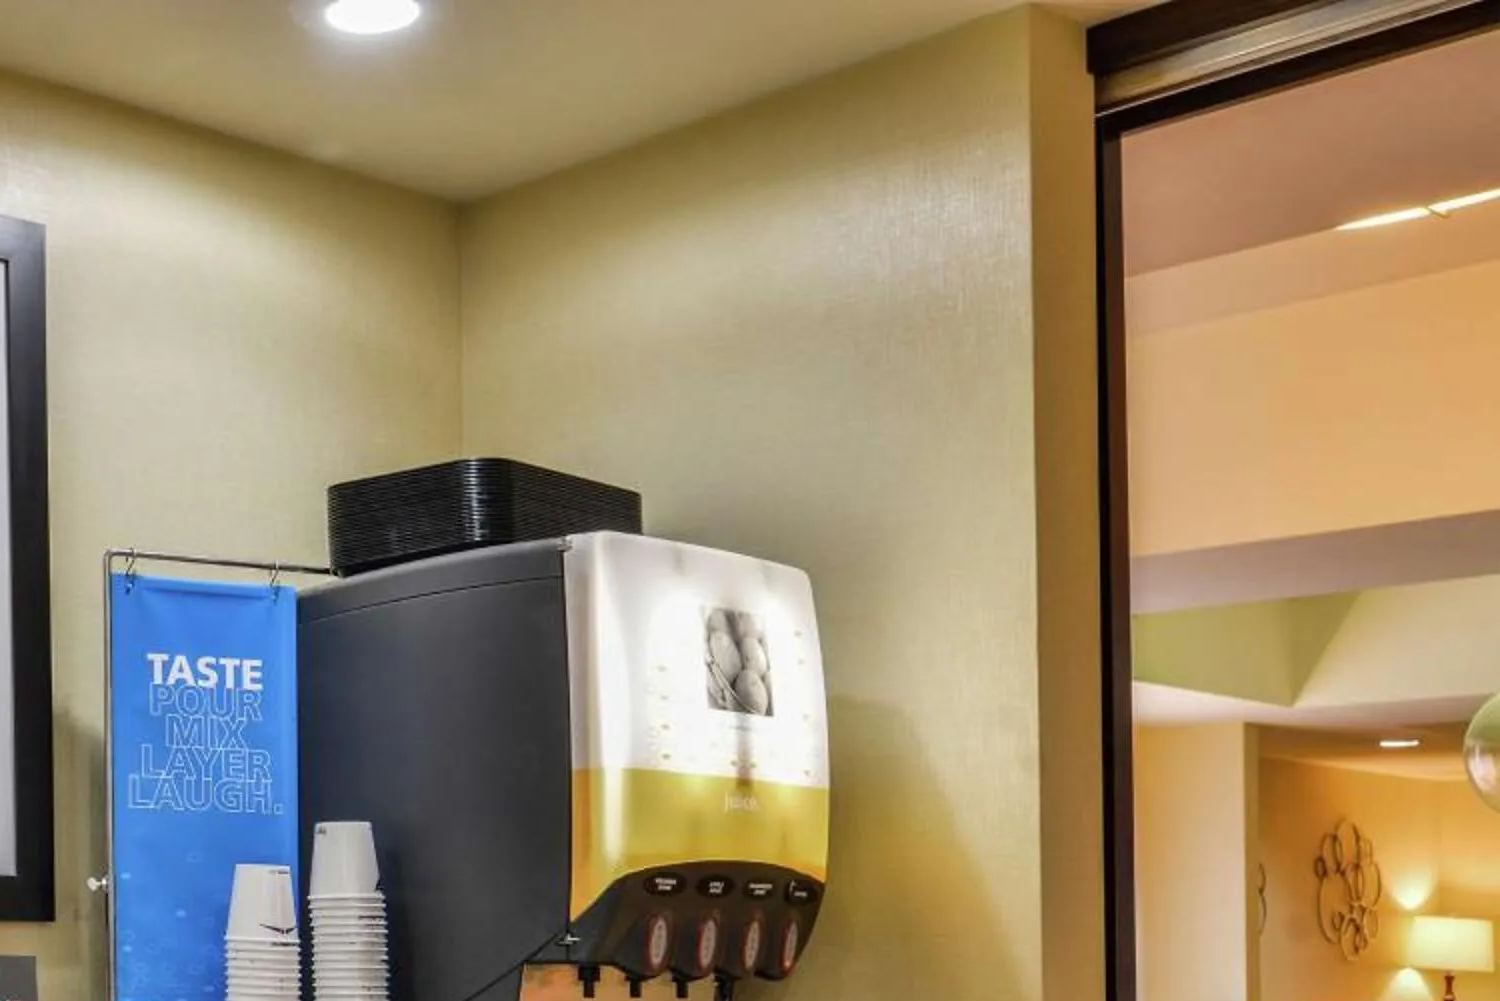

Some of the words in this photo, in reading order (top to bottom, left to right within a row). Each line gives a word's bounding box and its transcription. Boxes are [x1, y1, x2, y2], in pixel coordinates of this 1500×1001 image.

[147, 653, 263, 691] TASTE
[150, 682, 263, 721] POUR
[165, 714, 250, 750] MIX
[141, 743, 272, 782] LAYER
[129, 774, 284, 815] LAUGH.
